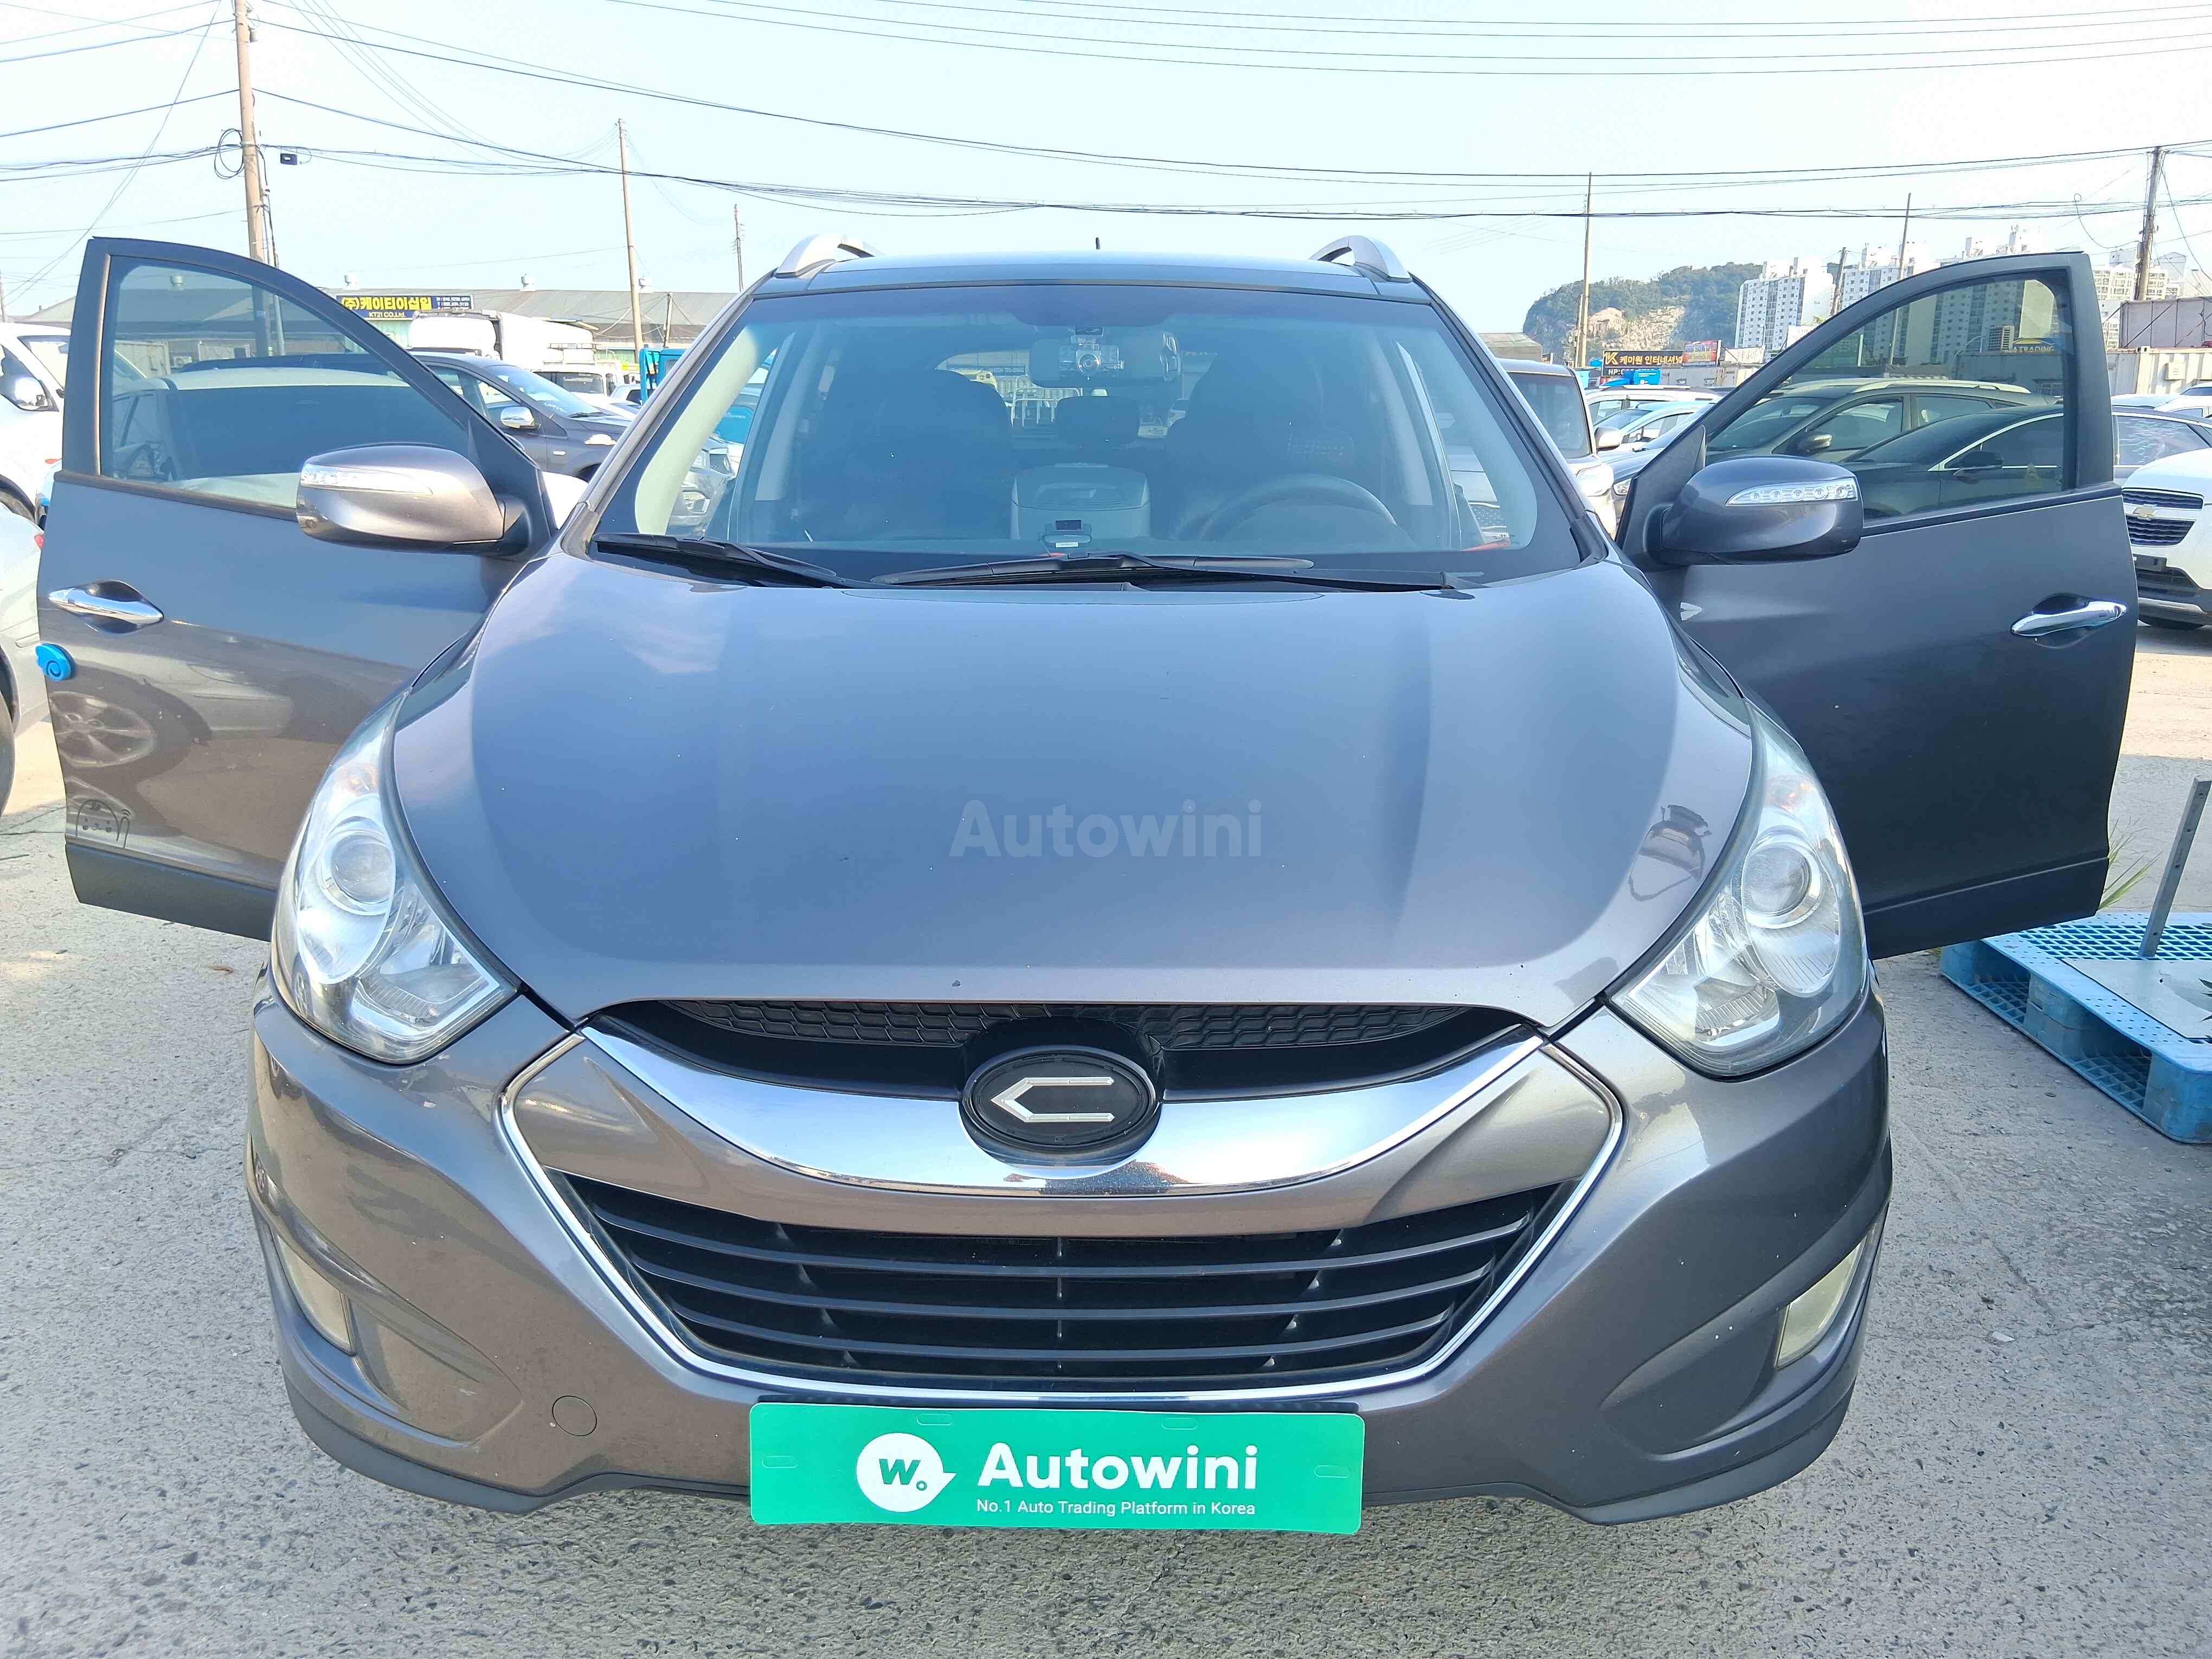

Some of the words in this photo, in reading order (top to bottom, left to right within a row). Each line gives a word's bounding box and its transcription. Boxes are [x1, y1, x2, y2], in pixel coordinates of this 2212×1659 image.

[341, 297, 432, 310] (주)케이티이십일
[1619, 356, 1643, 365] 케이원
[1644, 355, 1682, 365] 인터네셔널
[977, 1442, 1258, 1490] Autowini
[976, 1499, 1011, 1513] No.1
[1017, 1500, 1053, 1514] Auto
[1058, 1500, 1116, 1517] Trading
[1121, 1501, 1188, 1515] Platform
[1192, 1503, 1206, 1515] in
[1211, 1503, 1256, 1515] Korea
